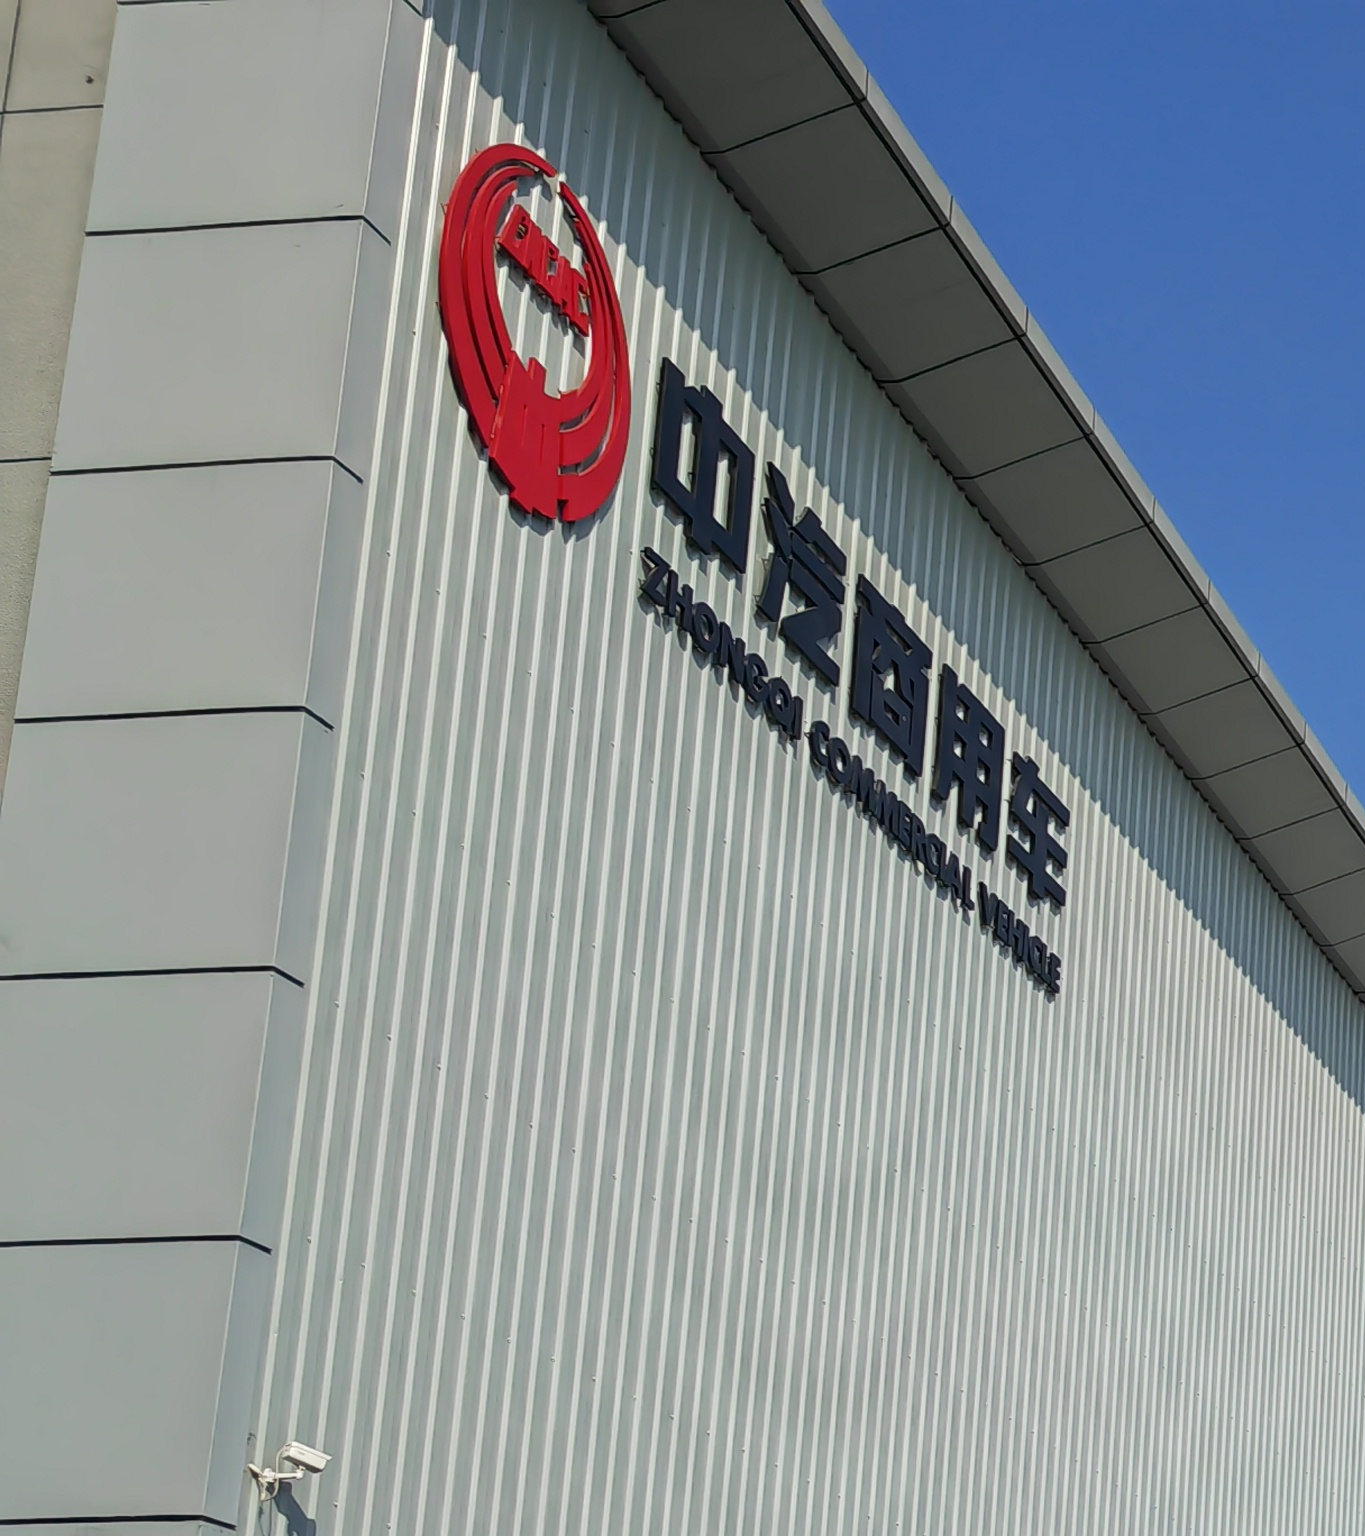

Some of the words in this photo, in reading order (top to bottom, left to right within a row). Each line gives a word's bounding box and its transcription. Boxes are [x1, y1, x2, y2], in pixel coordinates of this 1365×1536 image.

[640, 546, 803, 741] ZHONGQI
[808, 720, 975, 912] COMMERCIAL
[978, 881, 1063, 995] VEHICLE
[650, 356, 1071, 908] 中汽商用车
